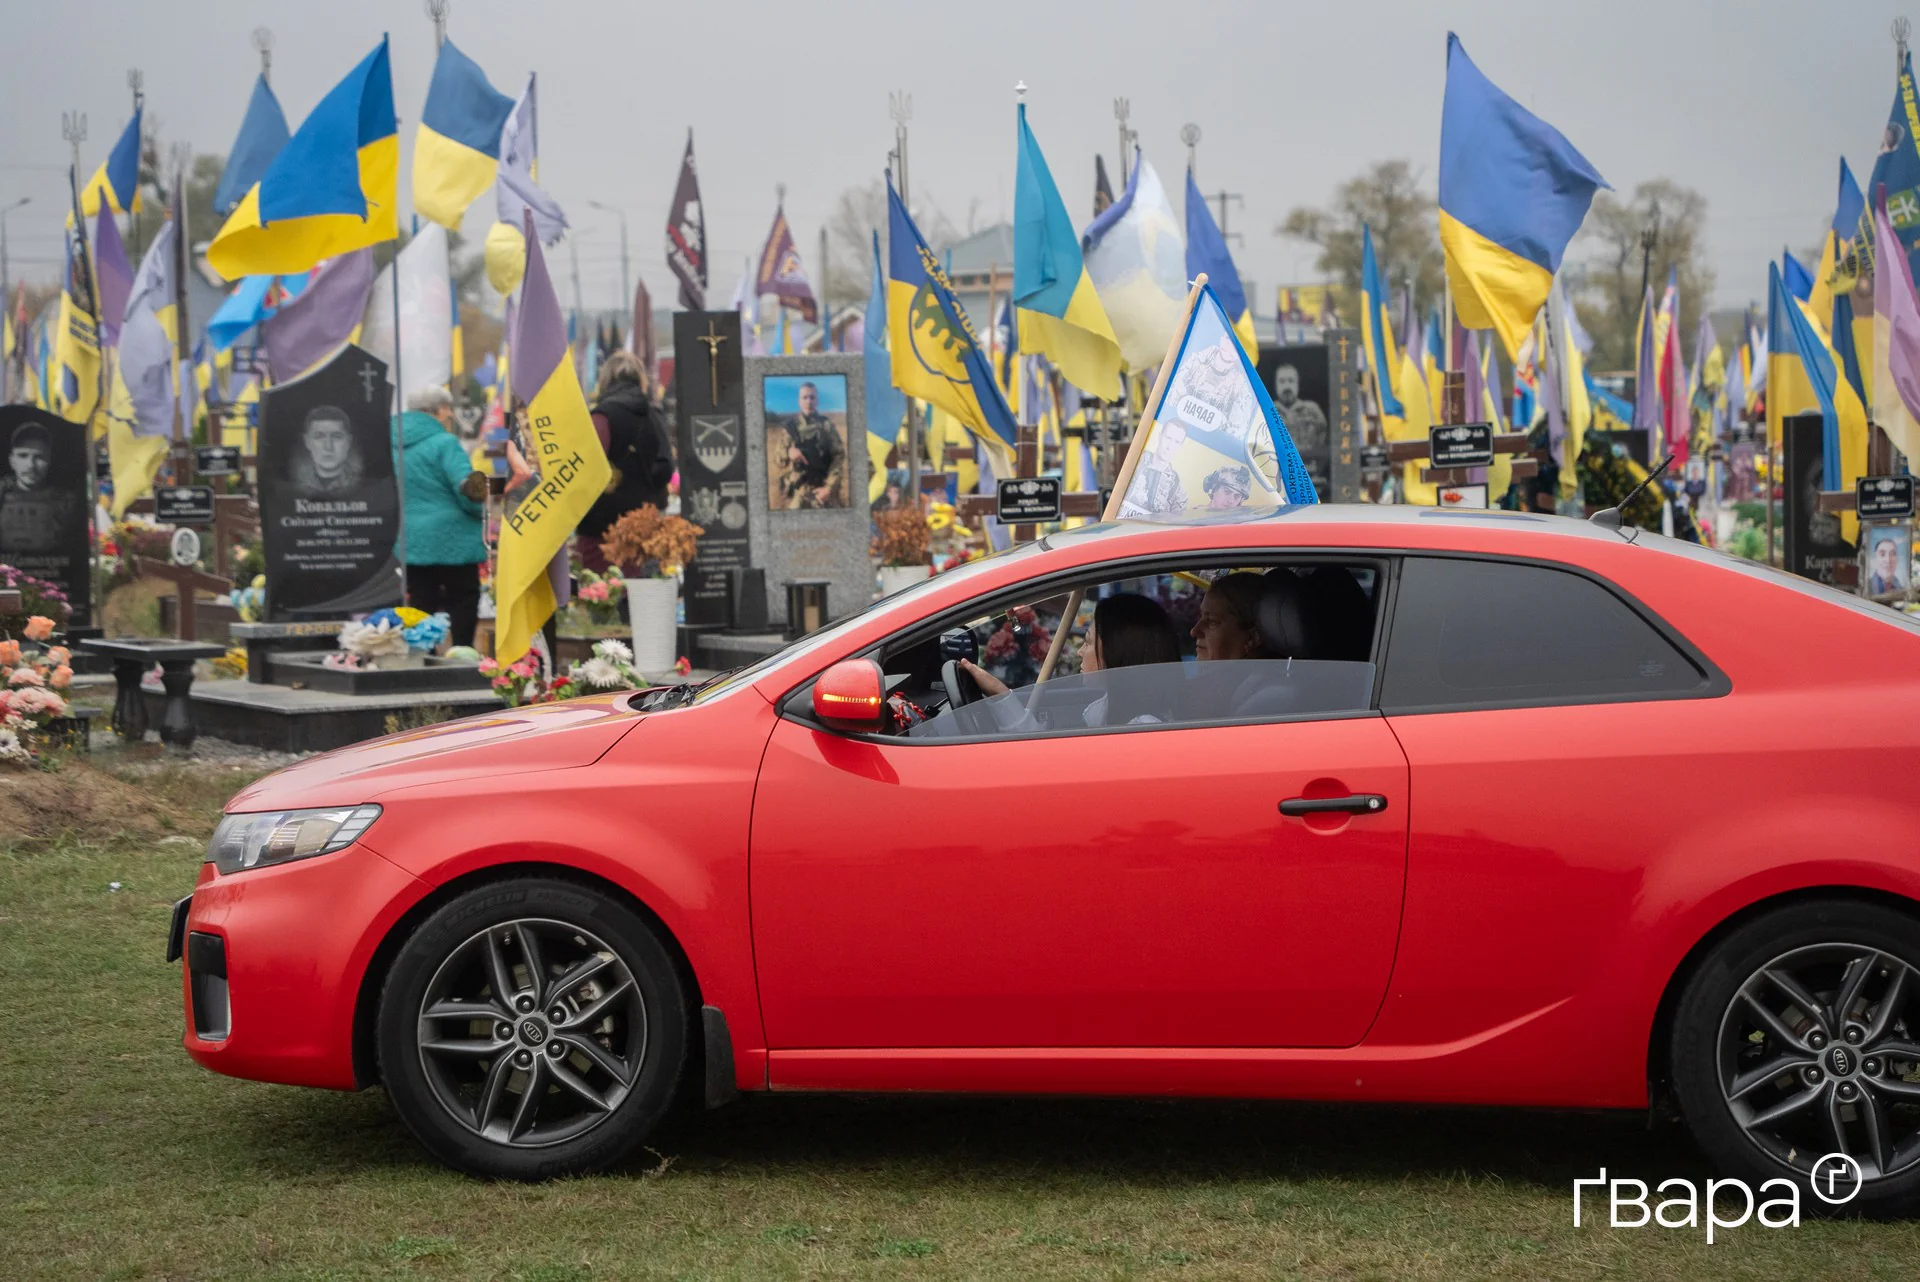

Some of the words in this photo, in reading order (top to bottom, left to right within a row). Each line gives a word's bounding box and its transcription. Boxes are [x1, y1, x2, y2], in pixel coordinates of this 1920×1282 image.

[535, 416, 562, 466] 1978
[1286, 452, 1297, 494] ОКРЕМА
[295, 499, 368, 513] Ковальов
[509, 451, 585, 536] PETRICH
[526, 1024, 541, 1040] KIA
[1835, 1053, 1846, 1071] KIA
